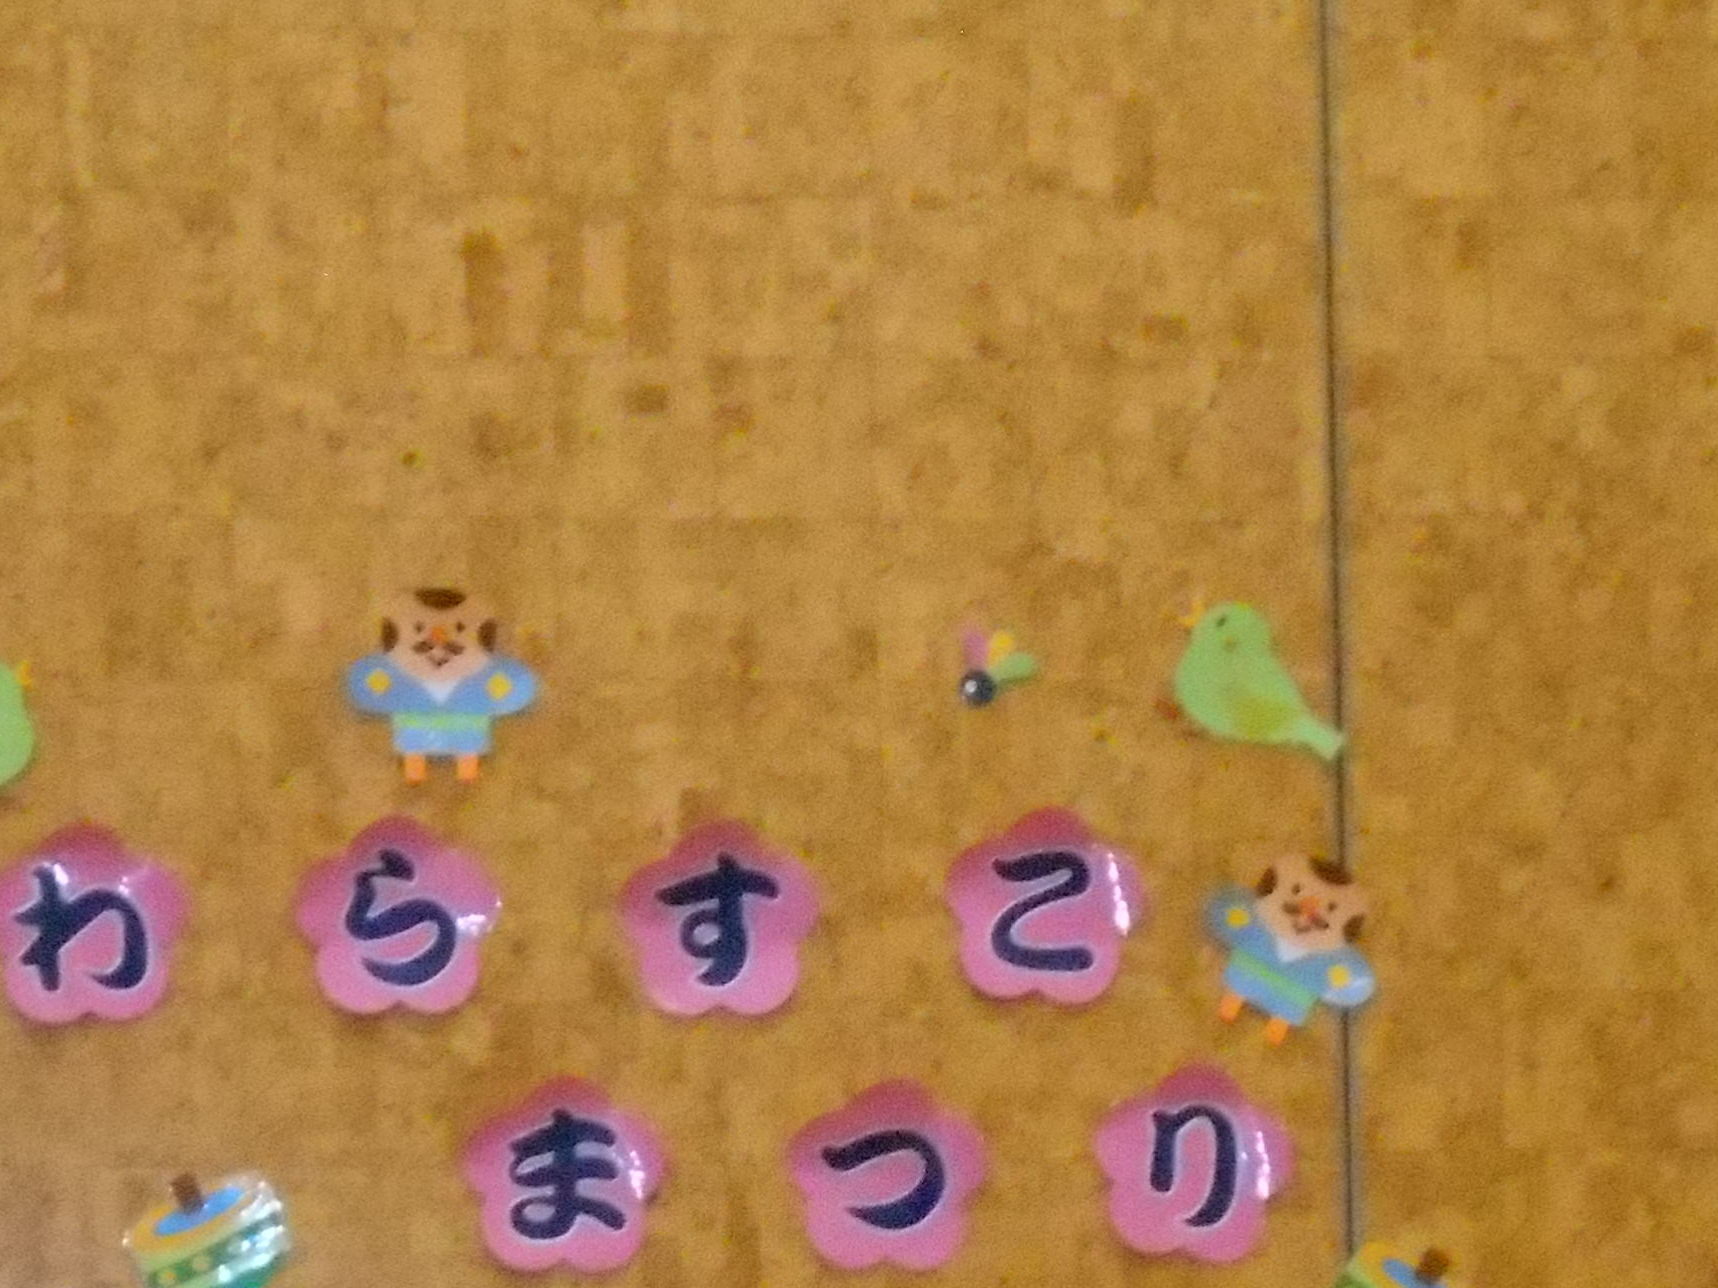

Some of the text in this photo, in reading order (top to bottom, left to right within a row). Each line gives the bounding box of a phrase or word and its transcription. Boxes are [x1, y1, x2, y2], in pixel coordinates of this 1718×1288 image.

[14, 848, 1094, 991] わらすこ
[511, 1105, 1237, 1238] まつり
